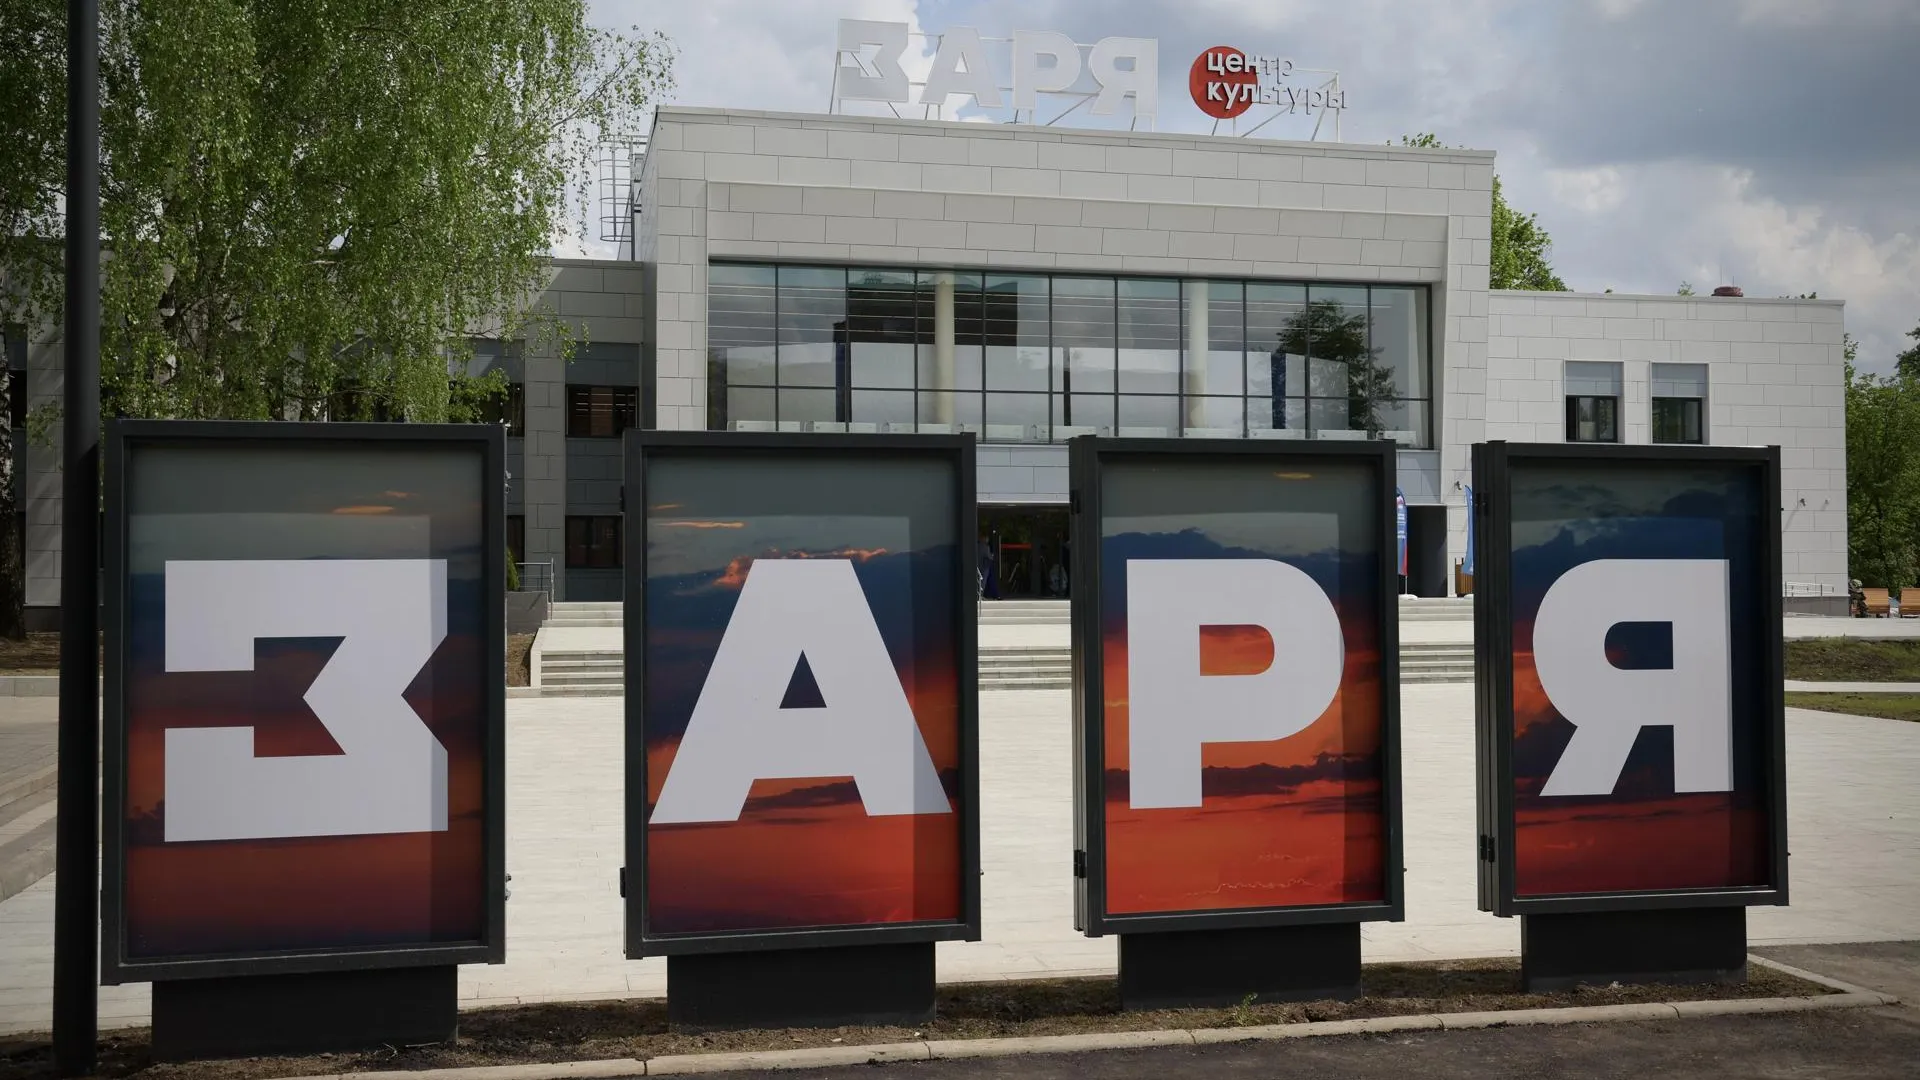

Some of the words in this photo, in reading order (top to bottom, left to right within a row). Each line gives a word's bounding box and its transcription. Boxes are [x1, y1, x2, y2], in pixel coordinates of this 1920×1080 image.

[839, 19, 1159, 117] ЗАРЯ
[1207, 52, 1295, 84] центр
[1207, 81, 1348, 115] культуры
